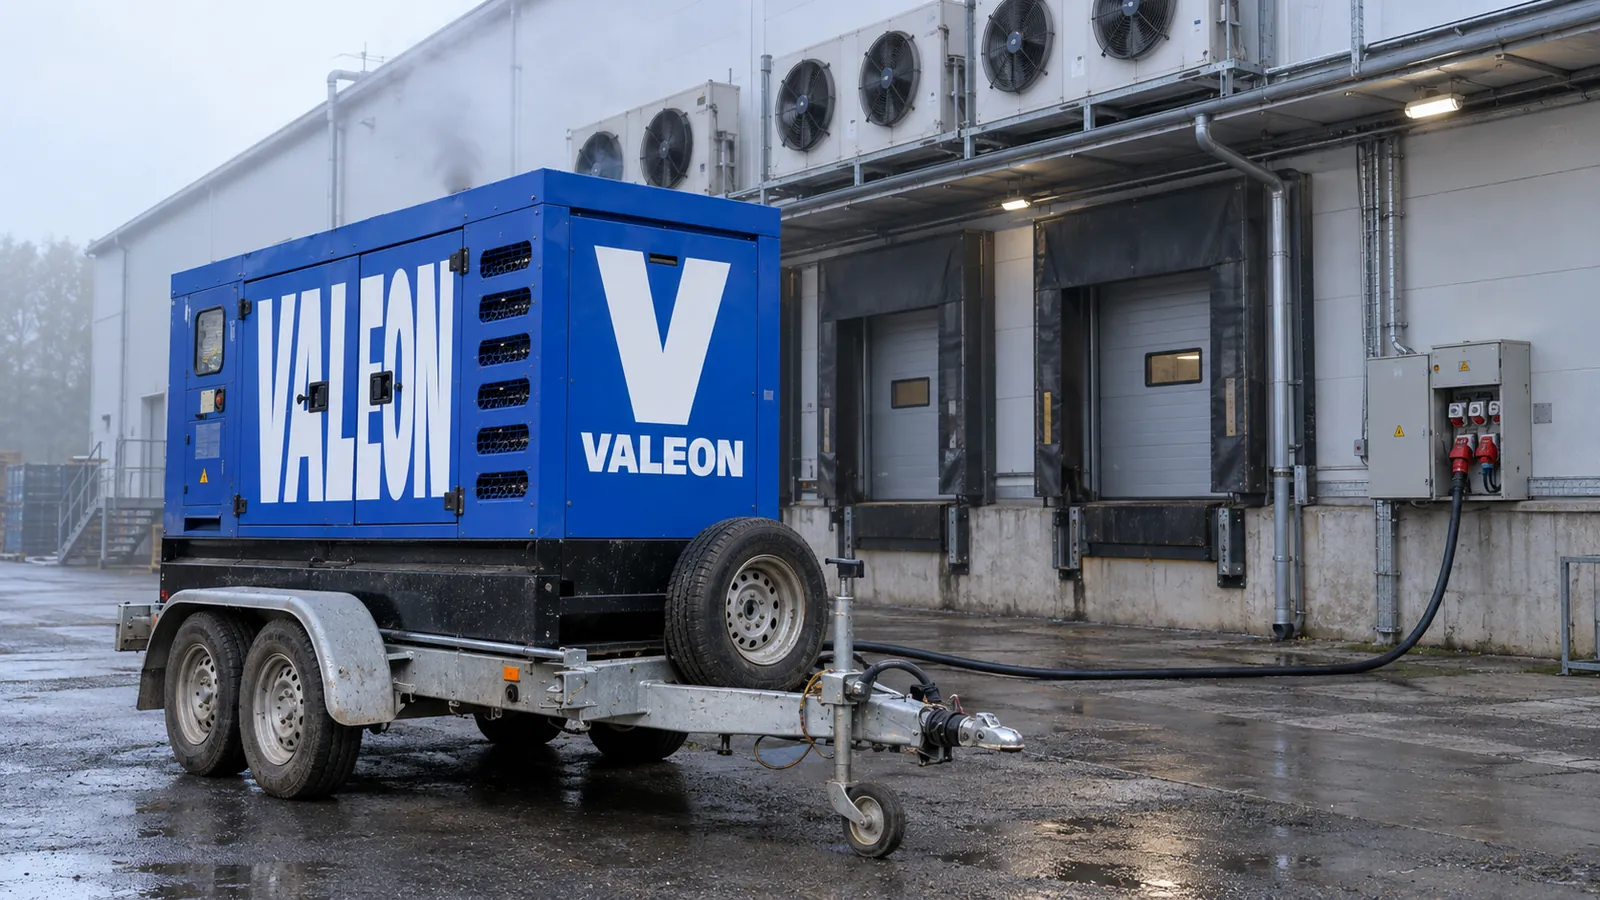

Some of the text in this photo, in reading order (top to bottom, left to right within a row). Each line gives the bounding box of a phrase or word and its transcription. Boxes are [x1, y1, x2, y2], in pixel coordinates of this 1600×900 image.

[257, 260, 454, 503] VALEON
[594, 245, 730, 425] V
[580, 431, 744, 478] VALEON
